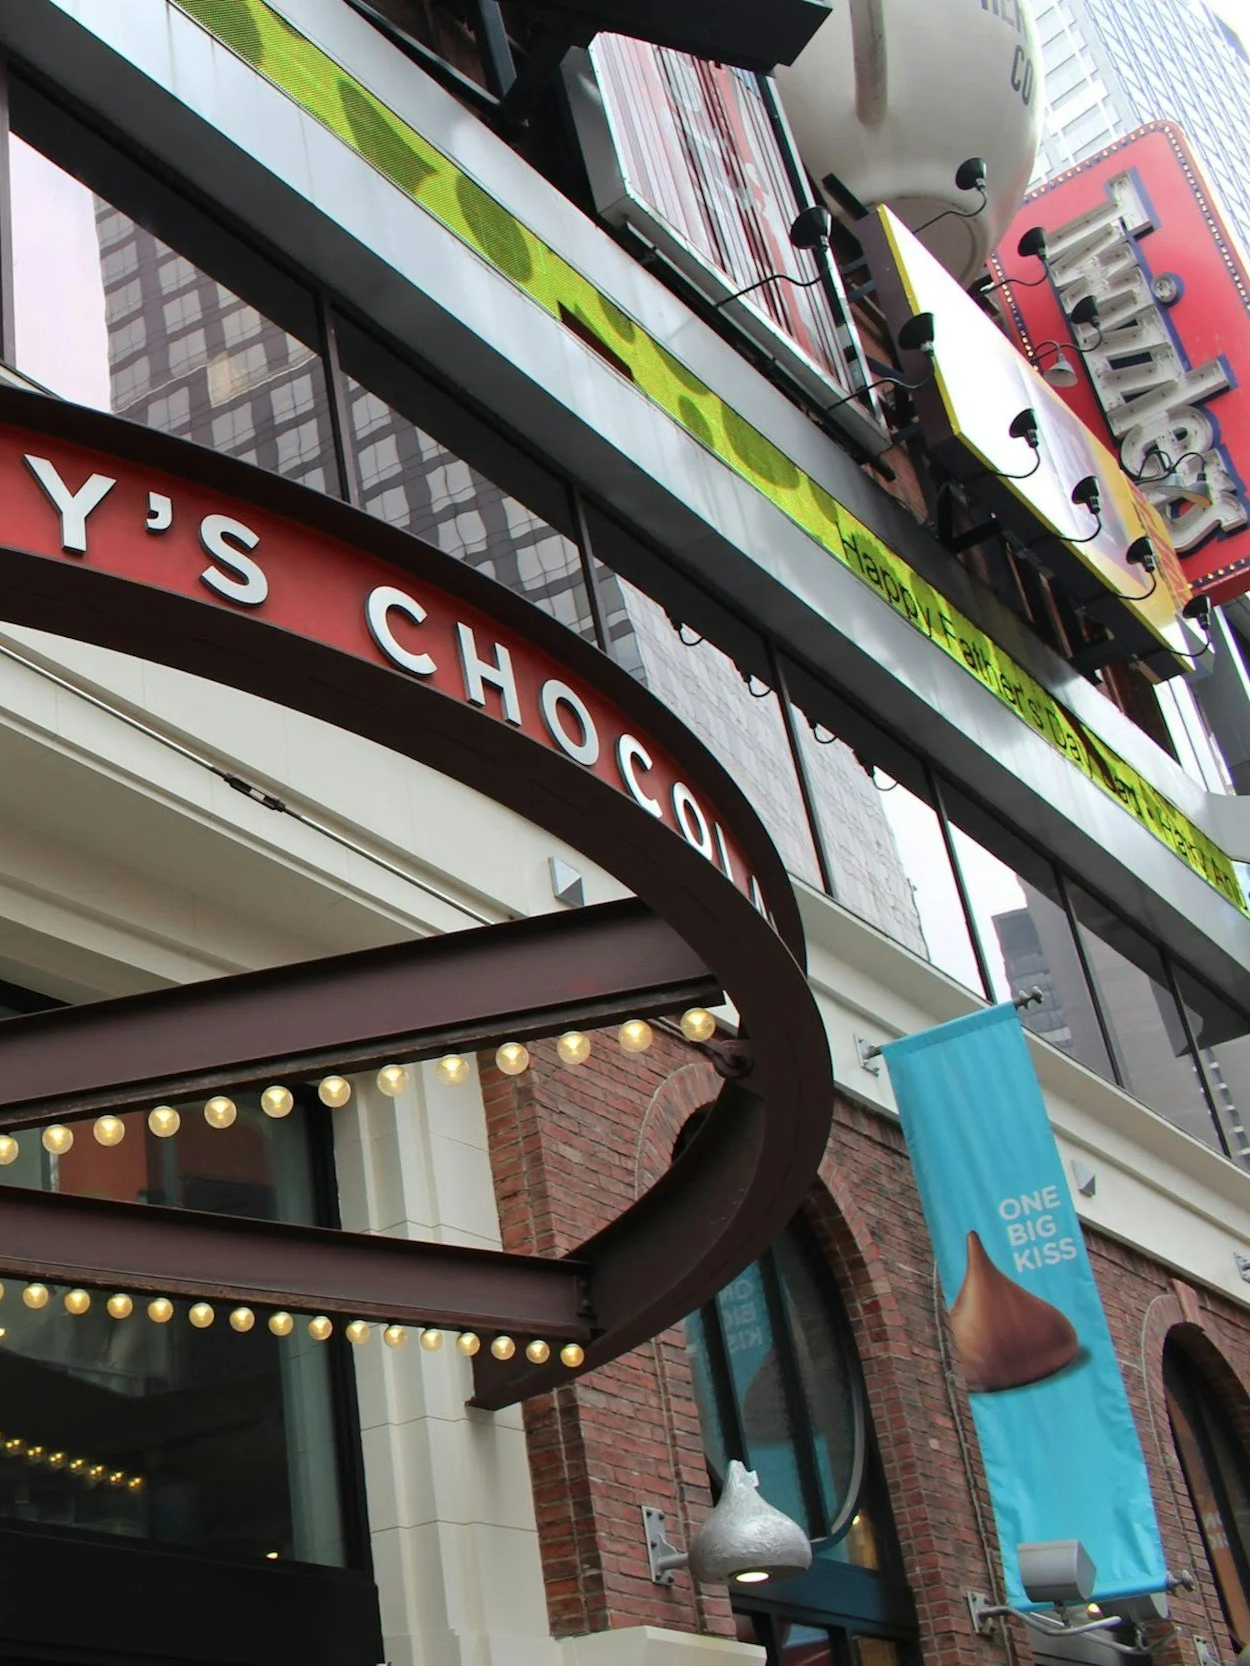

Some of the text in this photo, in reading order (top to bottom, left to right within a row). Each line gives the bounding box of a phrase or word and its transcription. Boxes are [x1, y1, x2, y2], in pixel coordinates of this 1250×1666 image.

[1046, 163, 1249, 555] Twizzlers
[836, 521, 932, 638] Happy
[1045, 707, 1094, 780] Day
[998, 1185, 1062, 1220] ONE
[1007, 1214, 1058, 1246] BIG
[1013, 1237, 1077, 1273] KISS
